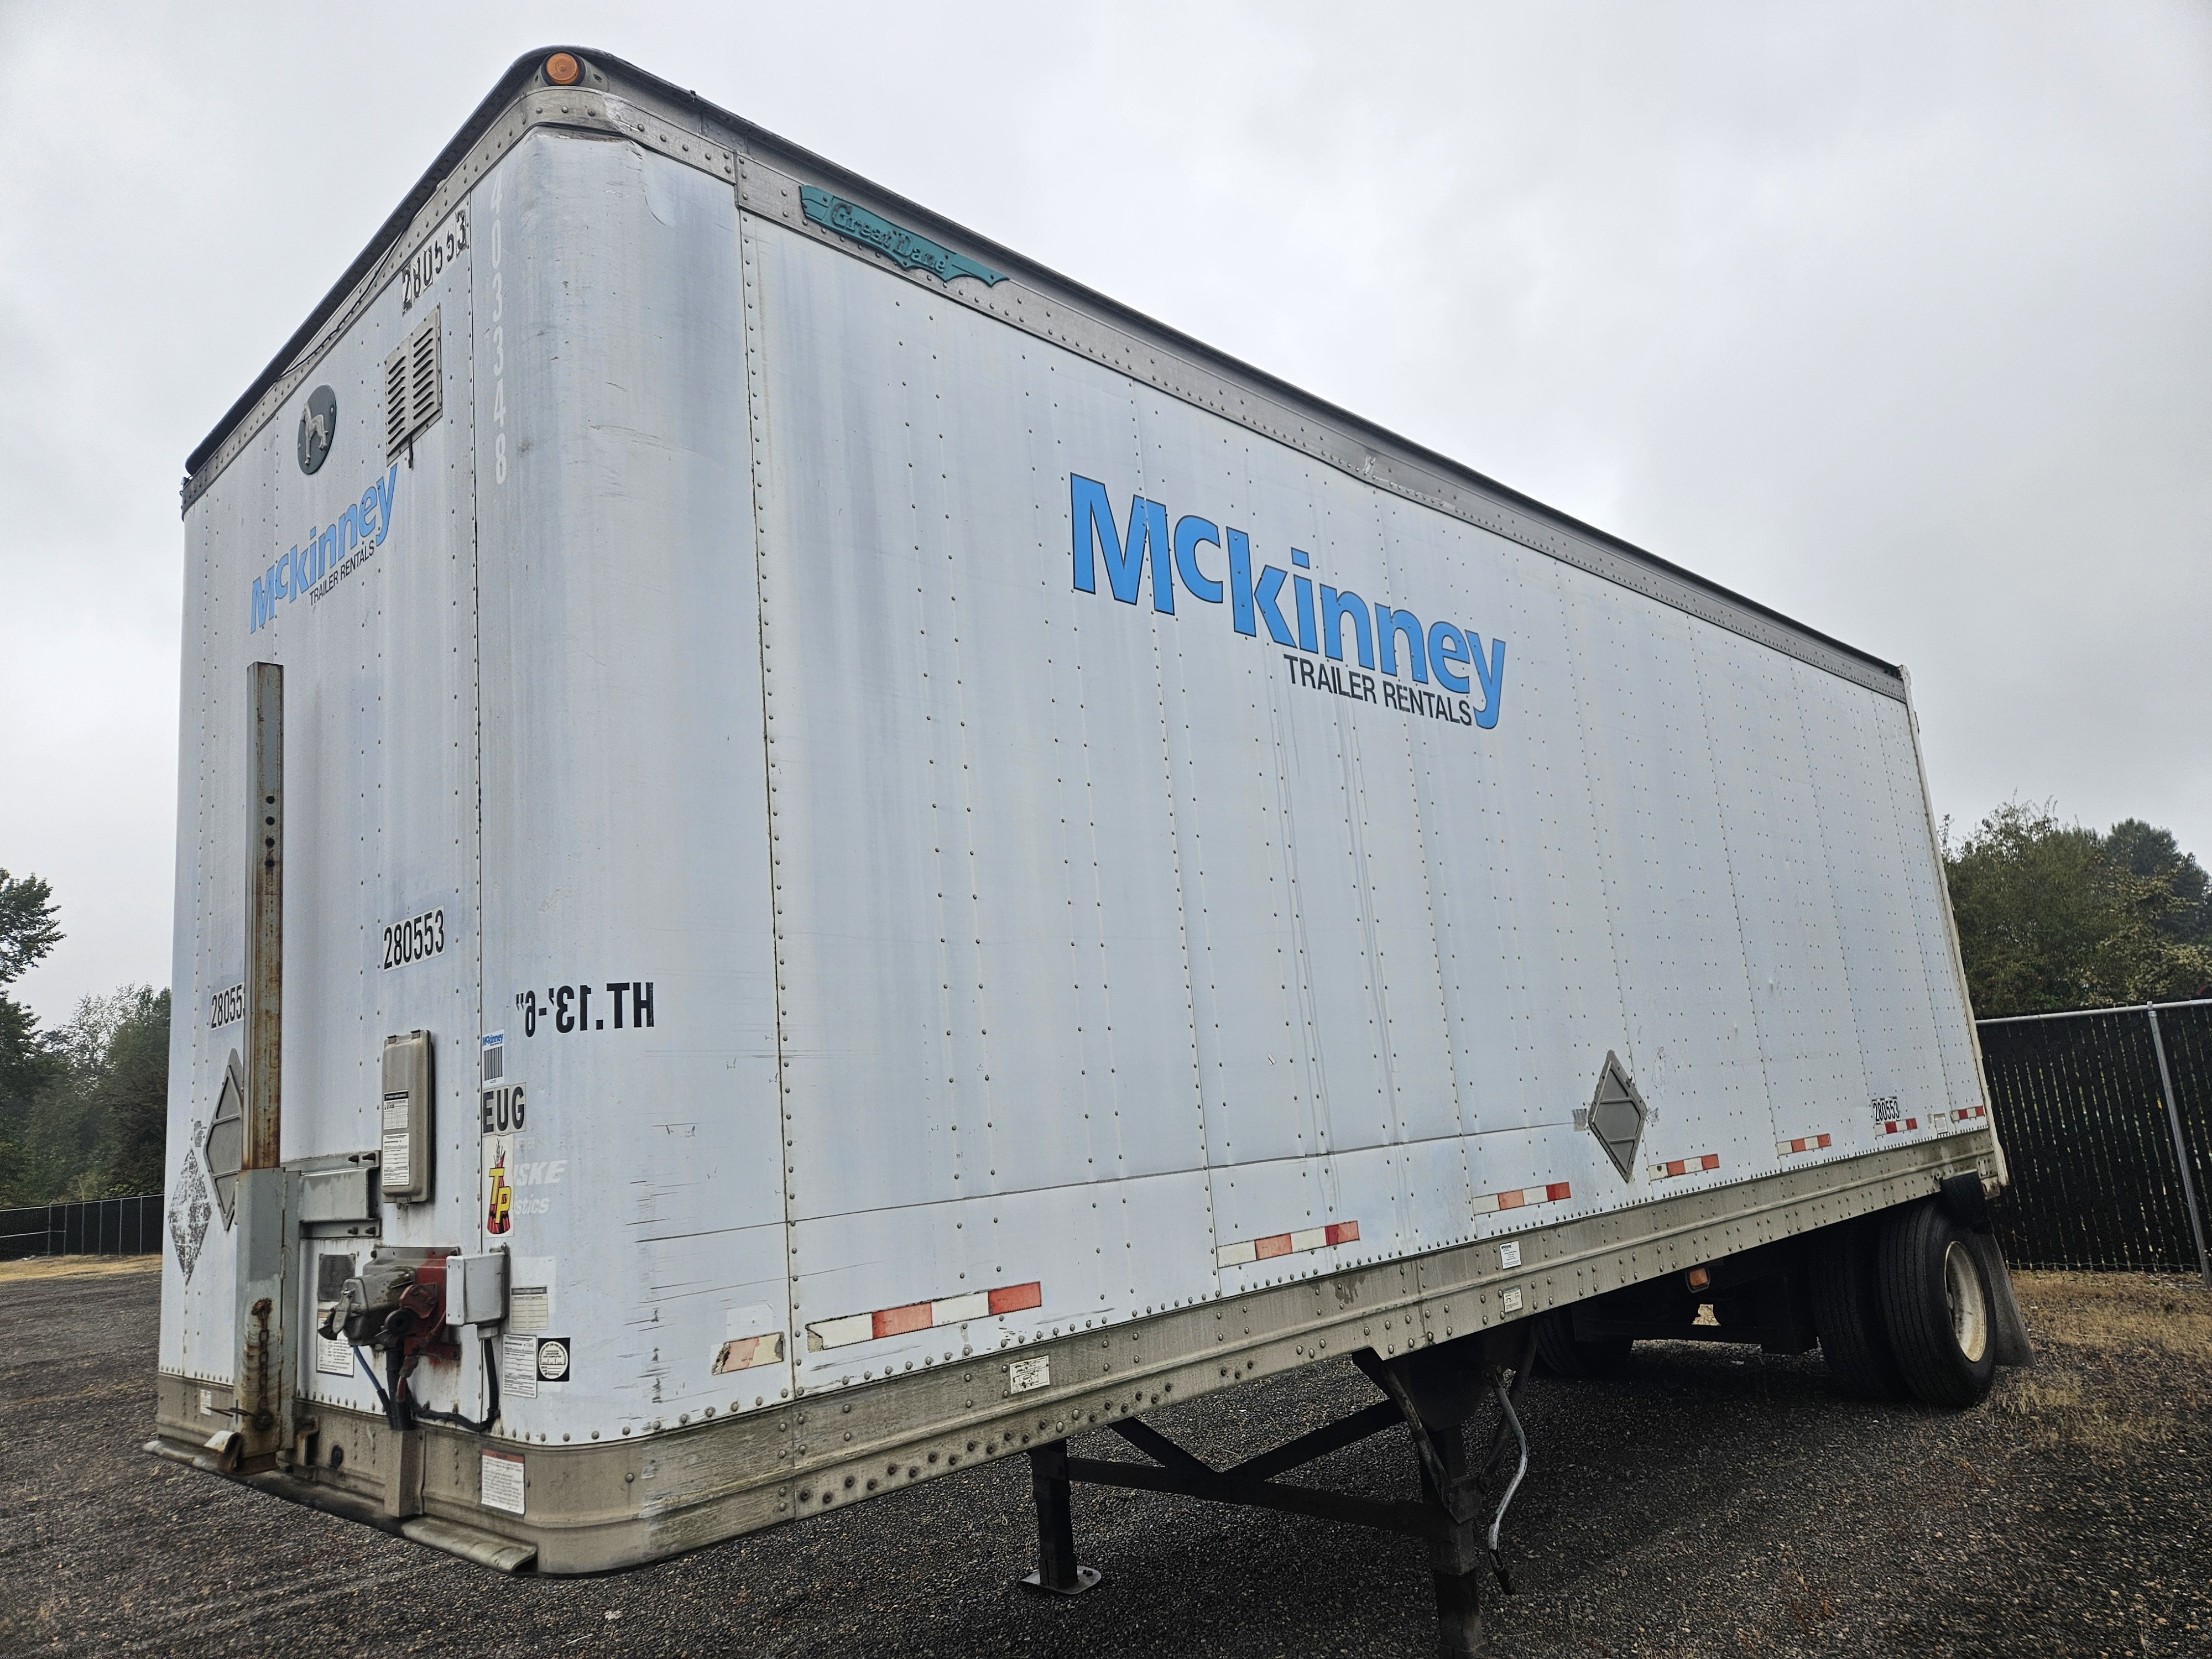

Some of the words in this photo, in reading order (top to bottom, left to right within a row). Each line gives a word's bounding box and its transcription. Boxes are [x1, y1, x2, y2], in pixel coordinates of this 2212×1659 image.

[832, 202, 891, 248] Great
[892, 232, 946, 273] Dane
[310, 570, 338, 606] TRAILER
[341, 540, 374, 581] RENTALS
[1283, 654, 1377, 704] TRAILER
[1383, 680, 1472, 726] RENTALS
[383, 909, 444, 970] 280553
[211, 984, 245, 1029] 28055
[483, 1087, 525, 1134] EUG
[1874, 1100, 1900, 1121] 280553
